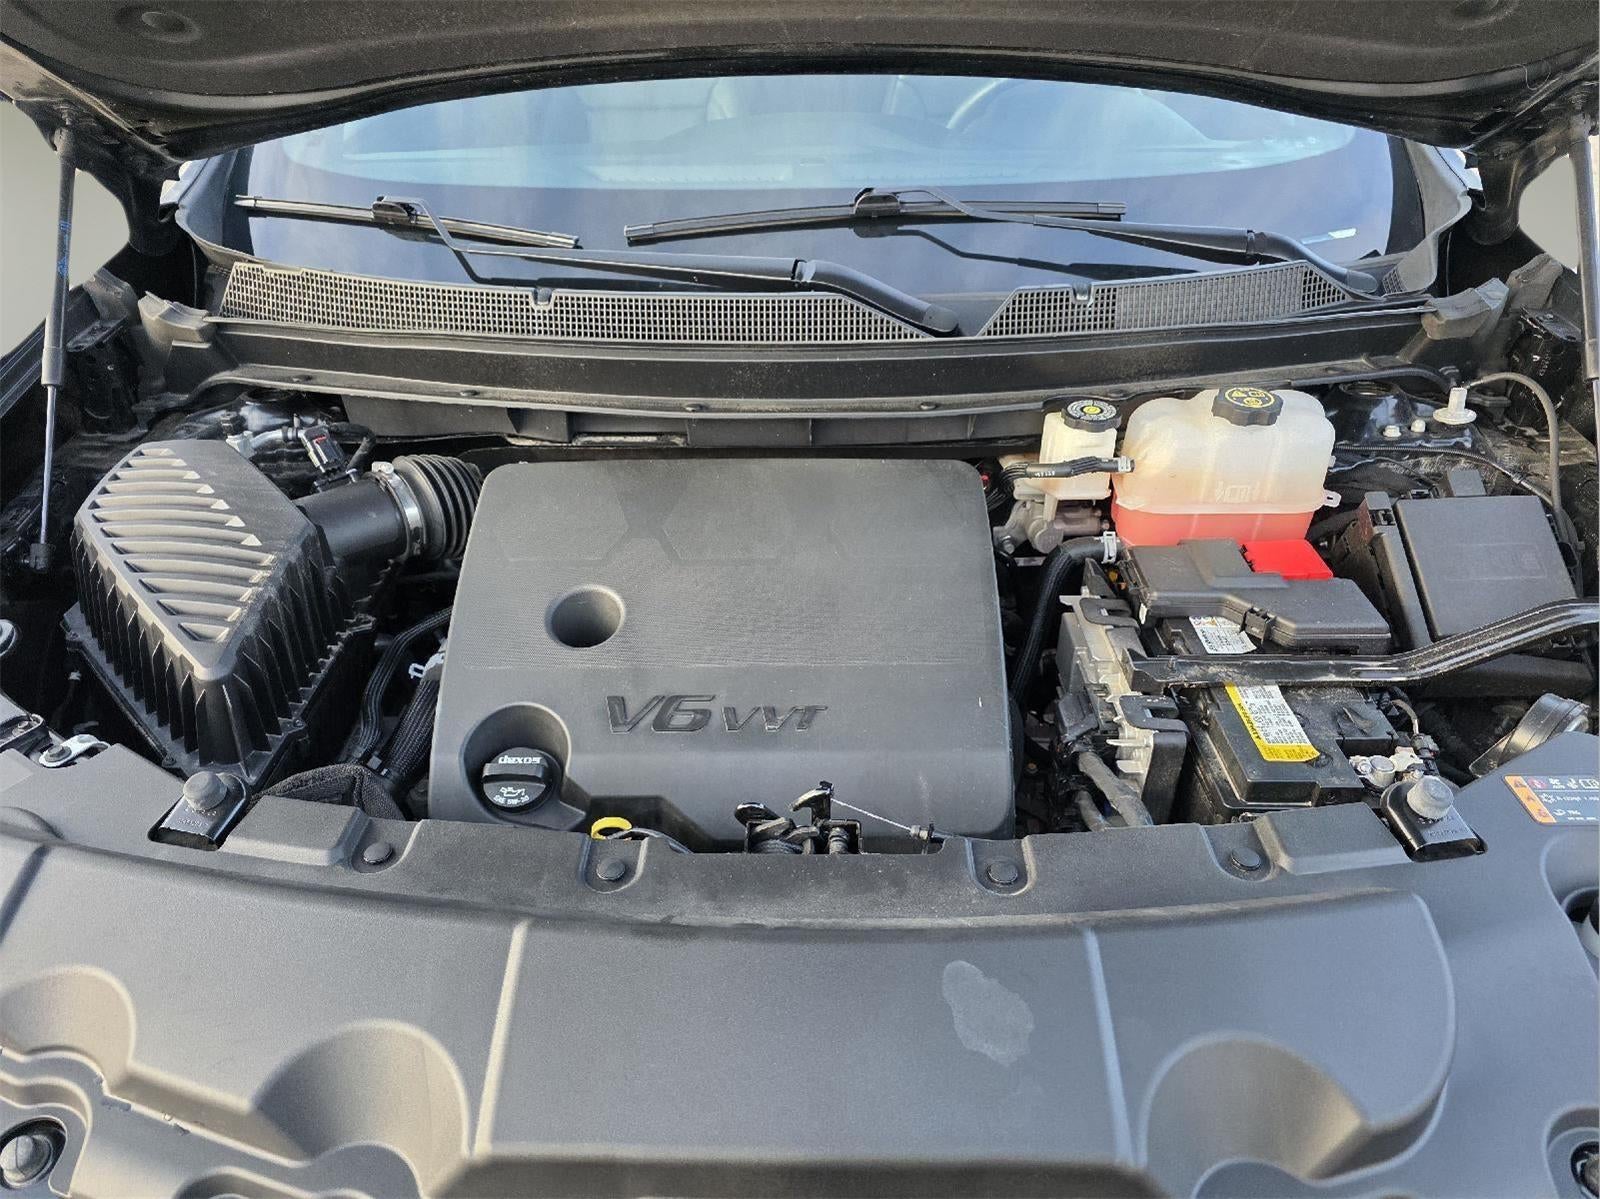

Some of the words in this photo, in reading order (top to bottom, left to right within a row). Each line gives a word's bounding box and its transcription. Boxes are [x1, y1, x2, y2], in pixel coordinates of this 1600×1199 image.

[606, 695, 716, 734] V6
[721, 704, 829, 732] VVT
[498, 755, 542, 764] dexos
